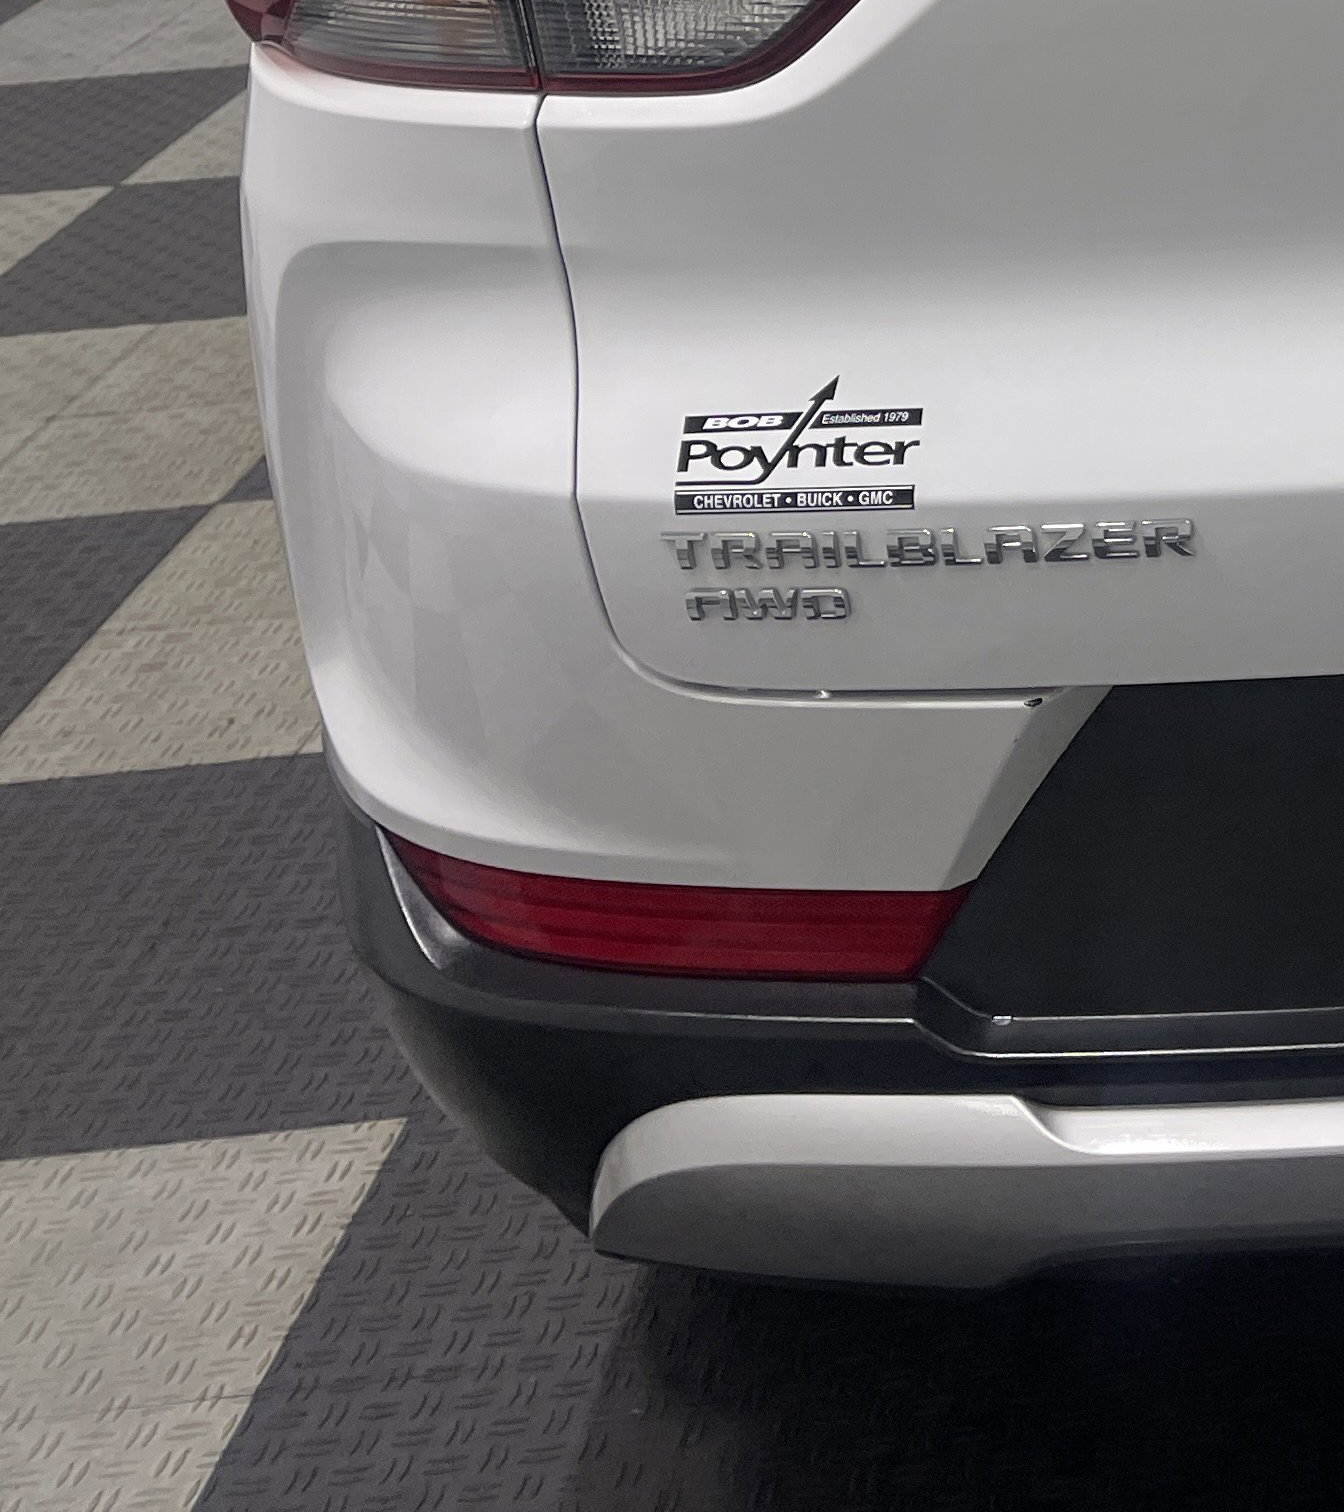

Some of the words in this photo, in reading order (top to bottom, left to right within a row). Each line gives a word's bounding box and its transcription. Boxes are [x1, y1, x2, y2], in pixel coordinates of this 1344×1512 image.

[702, 415, 784, 430] BOB
[821, 412, 881, 425] Established
[883, 410, 909, 423] 1979
[676, 436, 920, 485] Poynter
[693, 493, 781, 510] CHEVROLET
[796, 491, 843, 508] BUICK
[858, 490, 894, 506] GMC
[660, 518, 1196, 569] TRAILBLAZER
[685, 586, 852, 621] AWD
